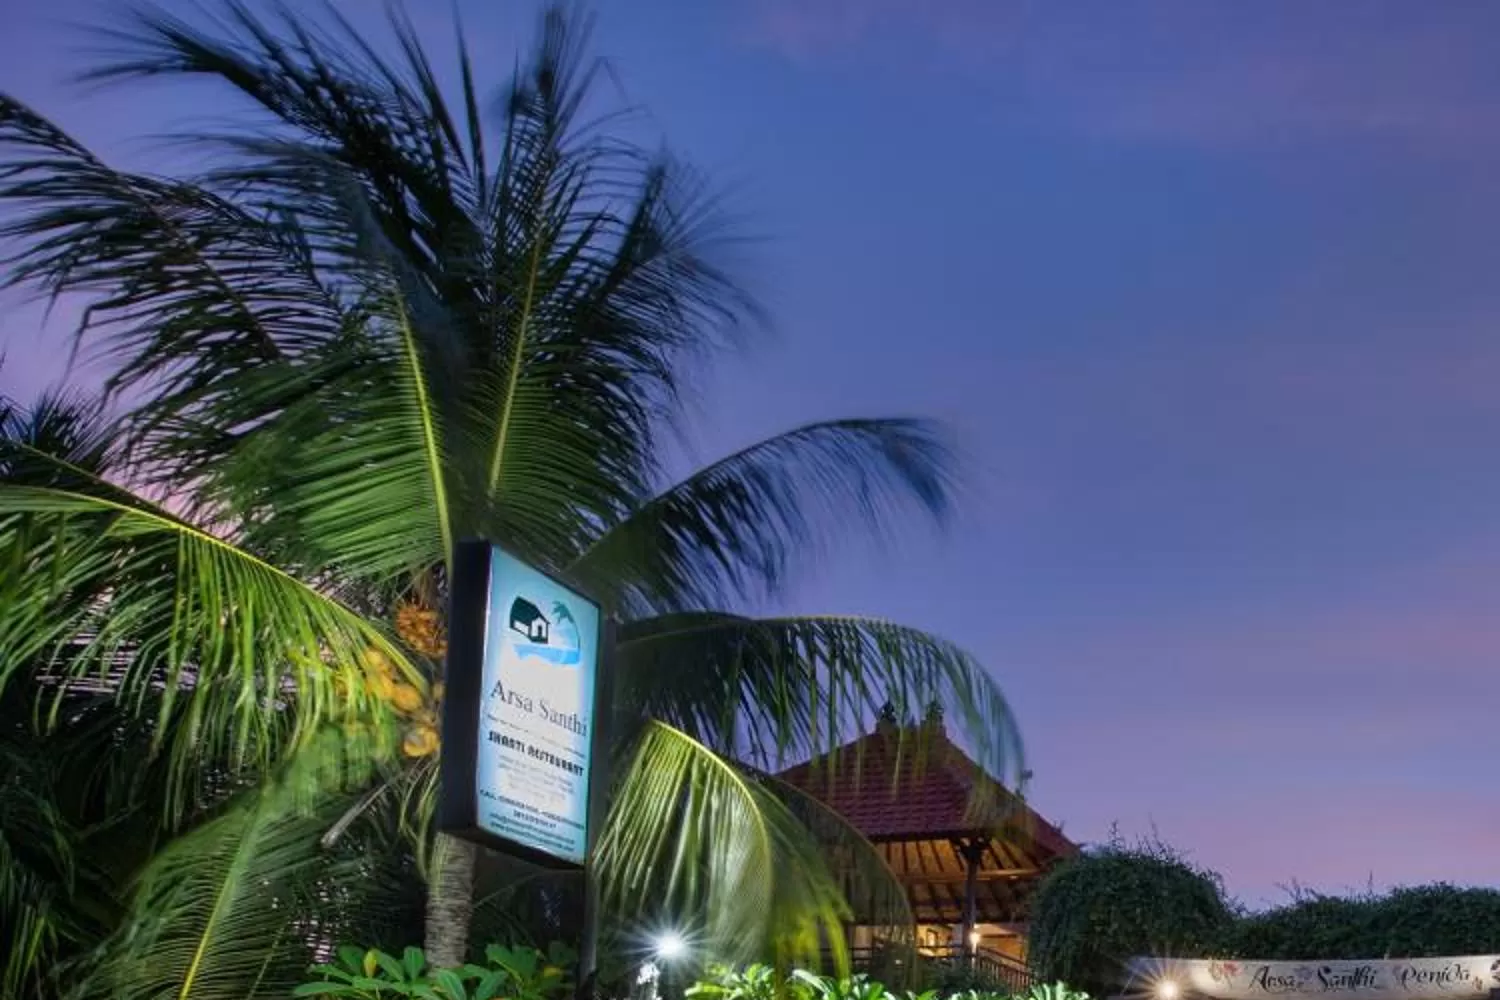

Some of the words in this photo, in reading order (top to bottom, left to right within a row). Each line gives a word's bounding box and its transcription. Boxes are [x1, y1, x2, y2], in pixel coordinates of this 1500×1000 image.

[490, 679, 533, 713] Arsa
[539, 698, 588, 737] Santhi
[1252, 965, 1297, 990] Arsa
[1316, 964, 1377, 992] Santhi
[1398, 963, 1472, 990] Penida
